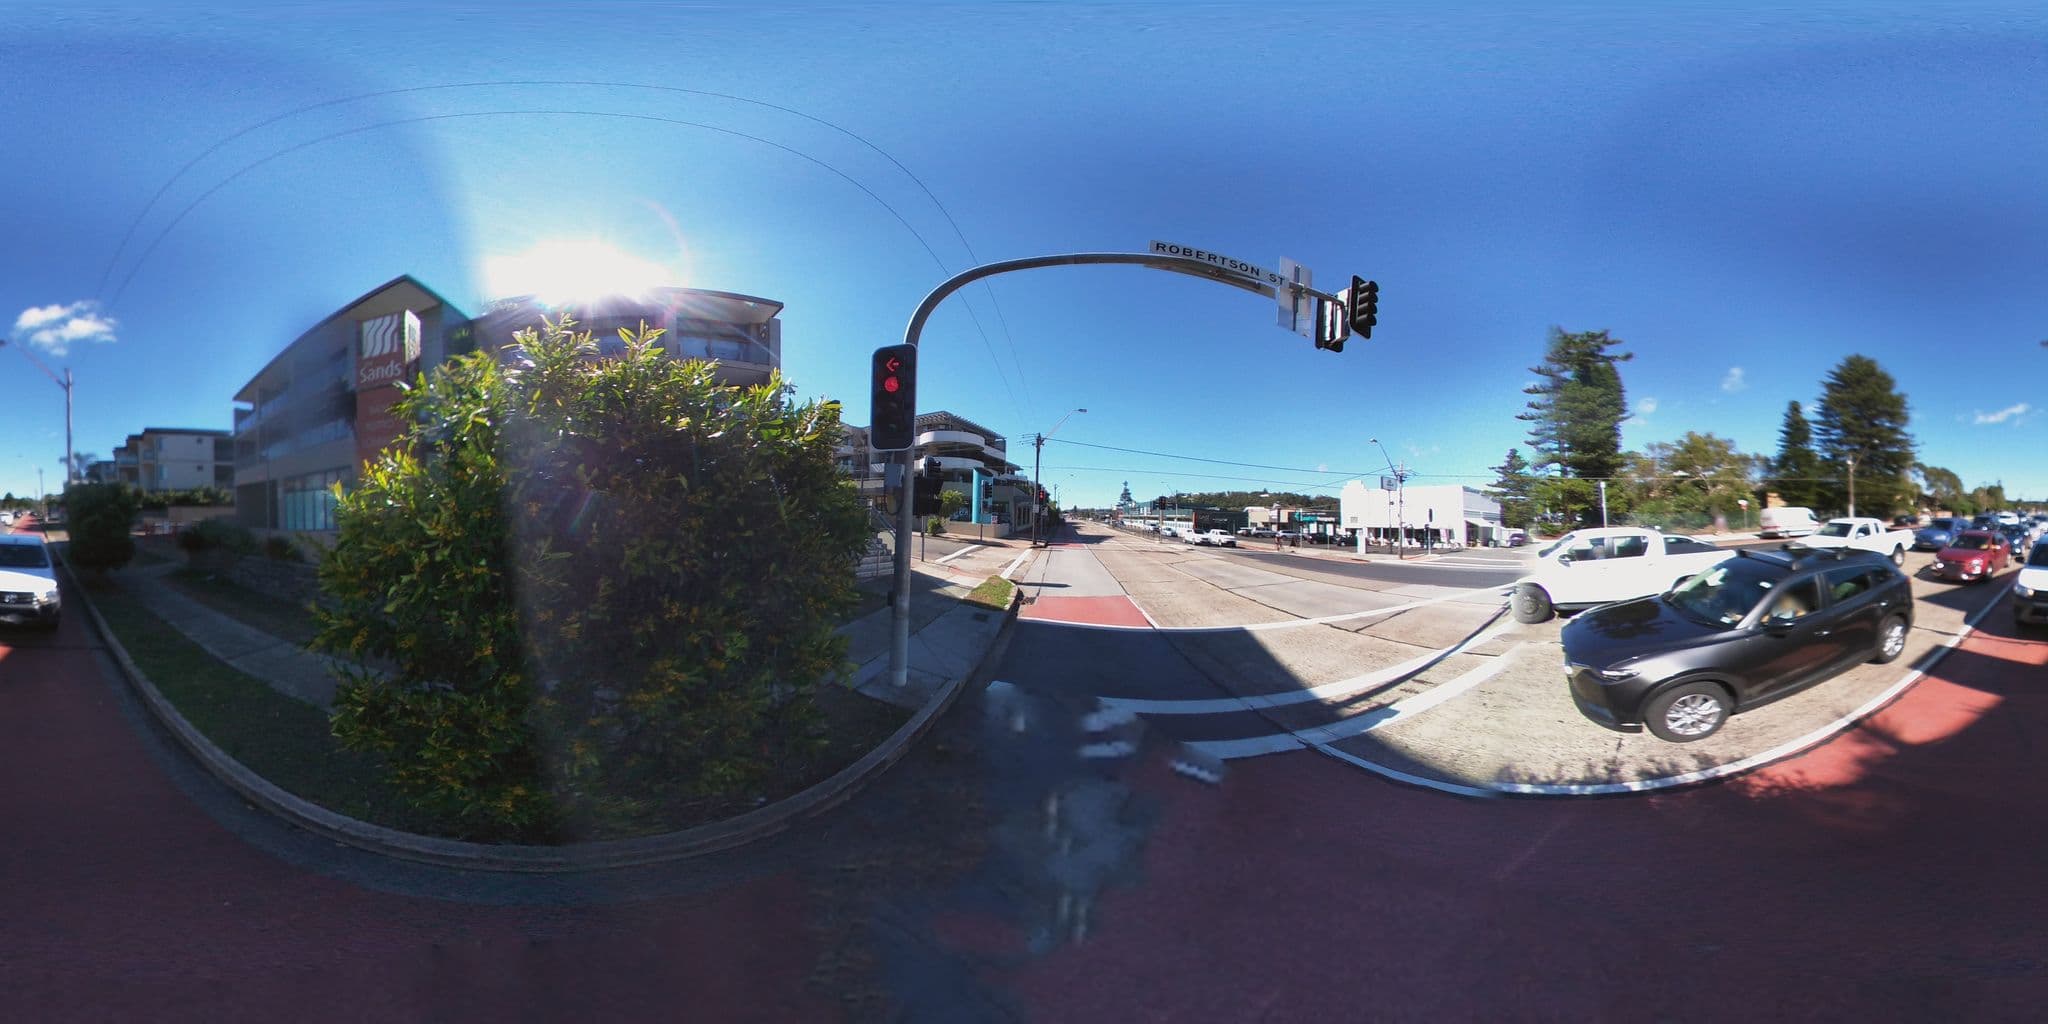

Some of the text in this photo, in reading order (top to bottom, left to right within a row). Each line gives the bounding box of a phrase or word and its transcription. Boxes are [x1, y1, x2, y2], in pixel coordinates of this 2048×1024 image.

[1155, 242, 1286, 286] ROBERTSON ST
[360, 360, 402, 384] Sands
